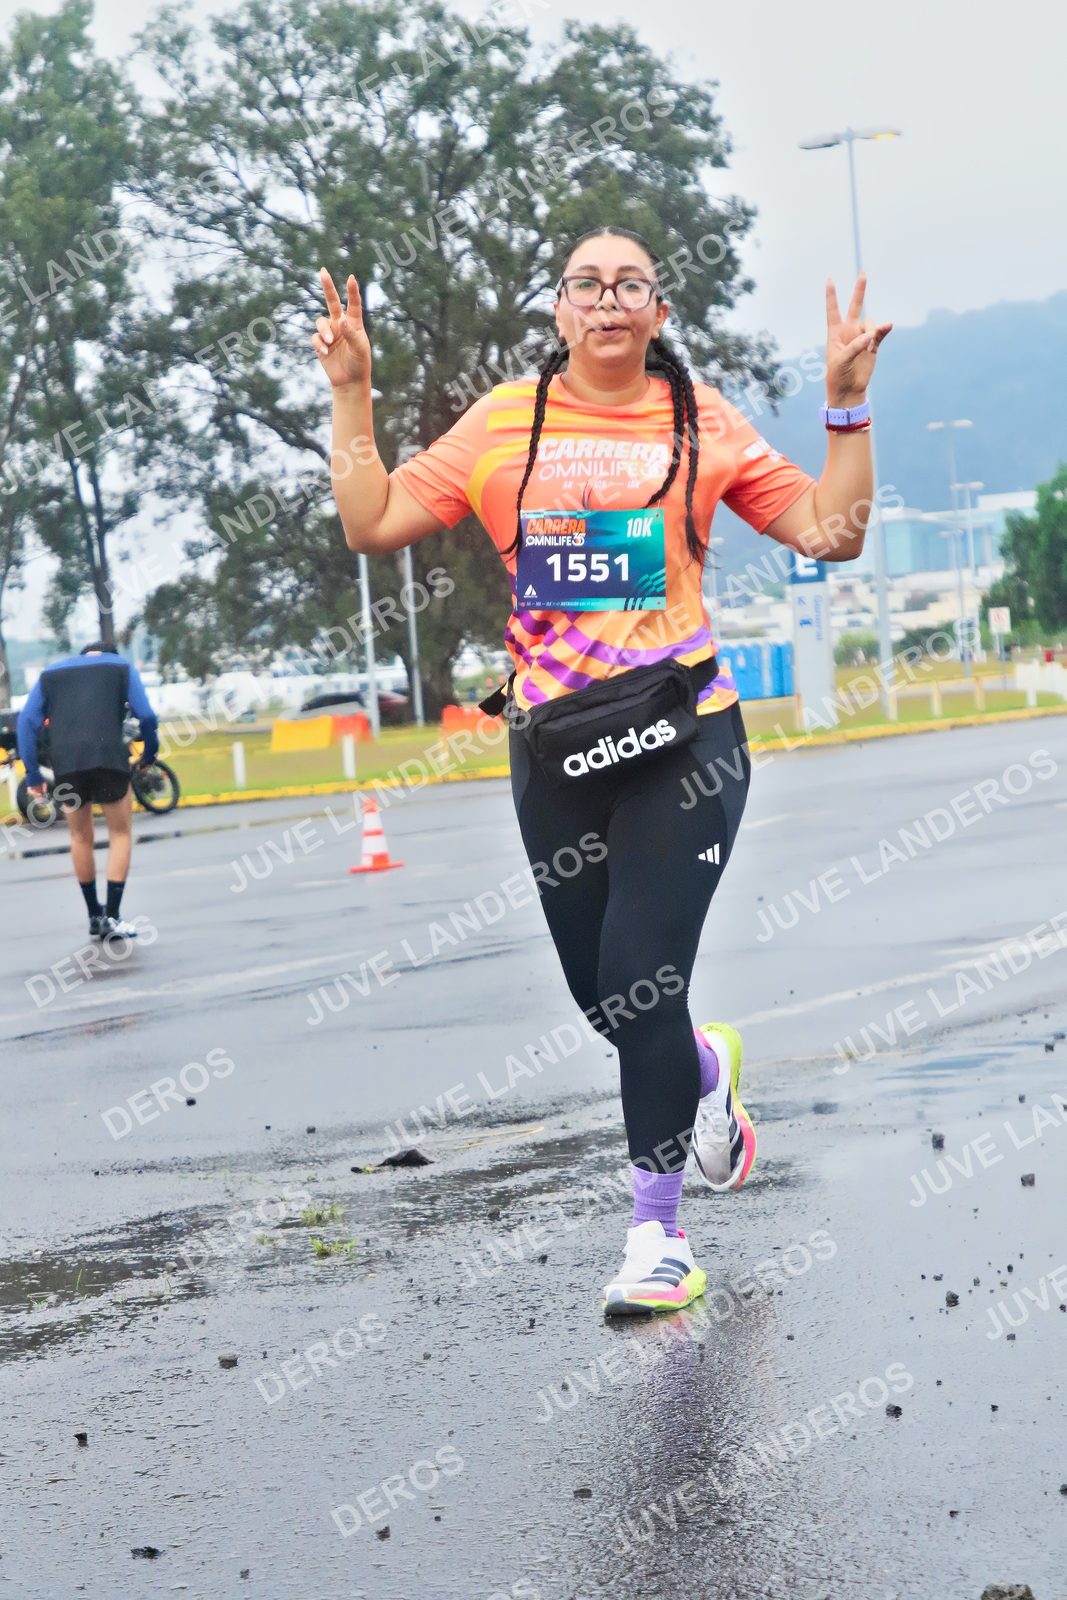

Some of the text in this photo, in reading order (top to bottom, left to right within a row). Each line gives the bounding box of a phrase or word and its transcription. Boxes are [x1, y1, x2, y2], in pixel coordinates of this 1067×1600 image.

[538, 438, 669, 463] CARRERA
[538, 461, 637, 480] OMNILIFE
[526, 518, 587, 535] CARRERA
[626, 517, 654, 538] 10K
[546, 553, 629, 582] 1551
[563, 719, 677, 777] adidas
